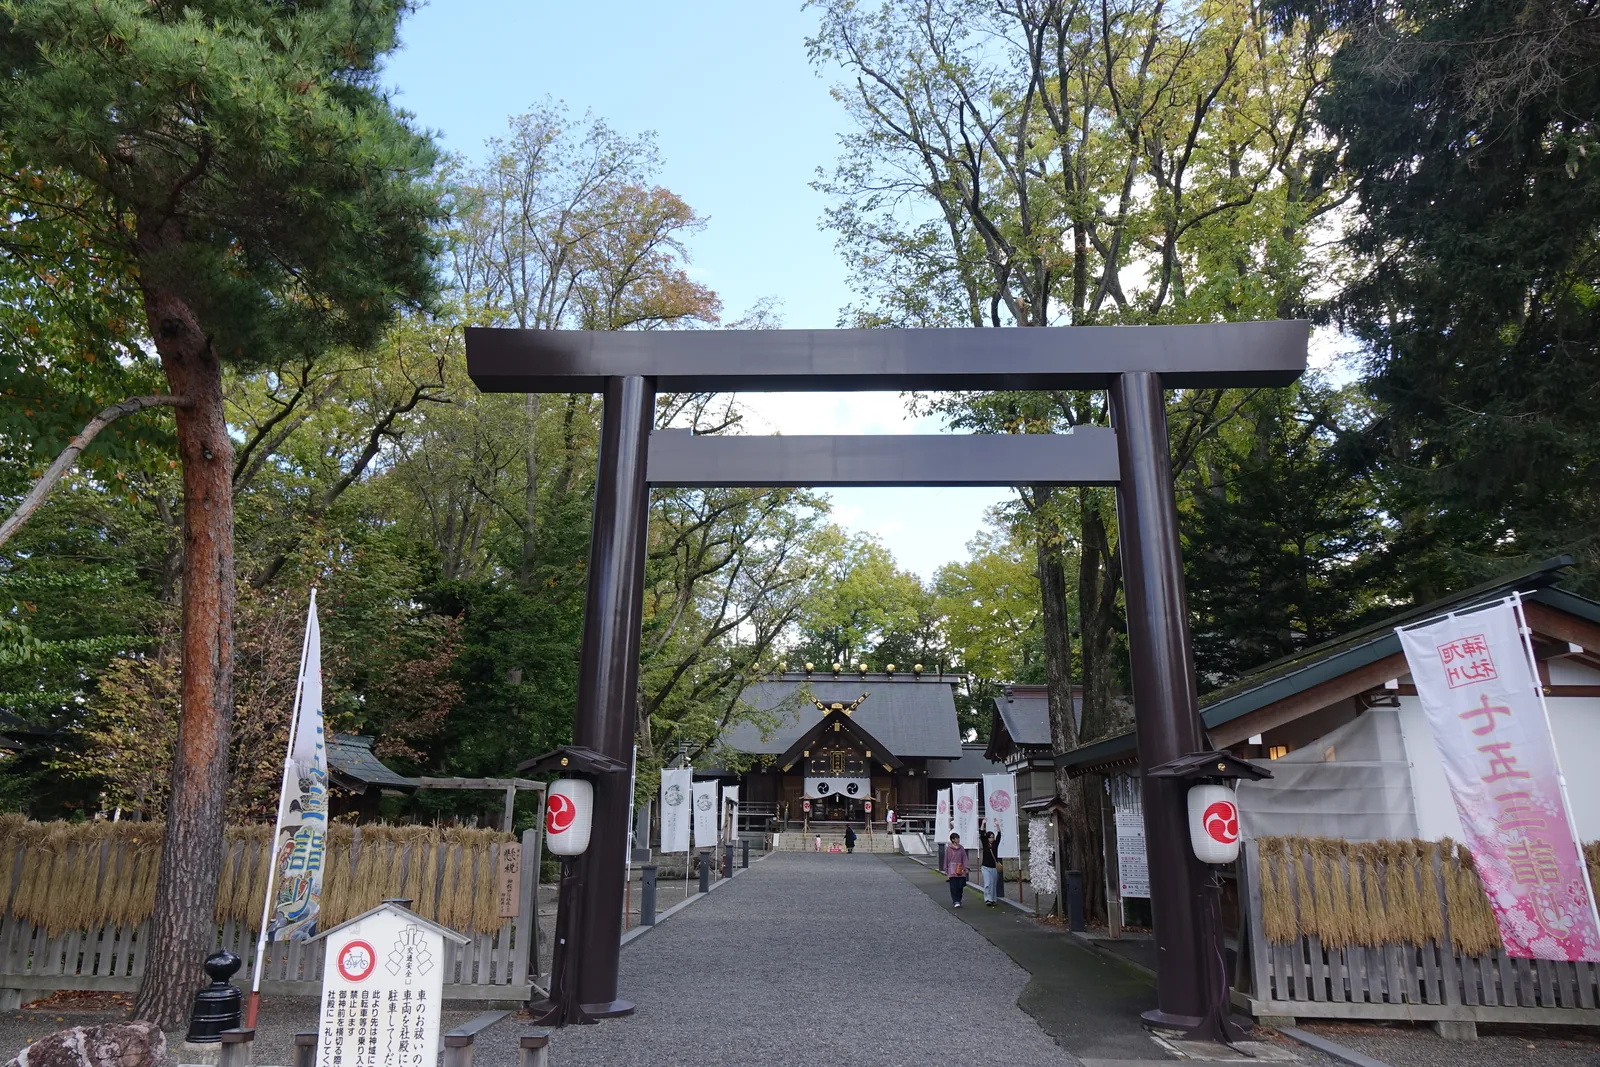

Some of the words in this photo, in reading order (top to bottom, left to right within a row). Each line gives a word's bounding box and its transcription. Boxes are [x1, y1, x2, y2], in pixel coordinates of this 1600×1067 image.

[405, 946, 413, 977] 交通安全
[322, 990, 335, 1067] 社殿に一礼してく
[333, 990, 347, 1067] 御神前を横切る際
[347, 990, 358, 1037] 禁止します
[356, 990, 369, 1067] 自転車等の乗り入
[367, 990, 380, 1067] 此より先は神域に
[384, 989, 398, 1067] 駐車してくだ
[398, 989, 412, 1067] 車両を社殿に
[412, 989, 427, 1067] 車のお祓いの
